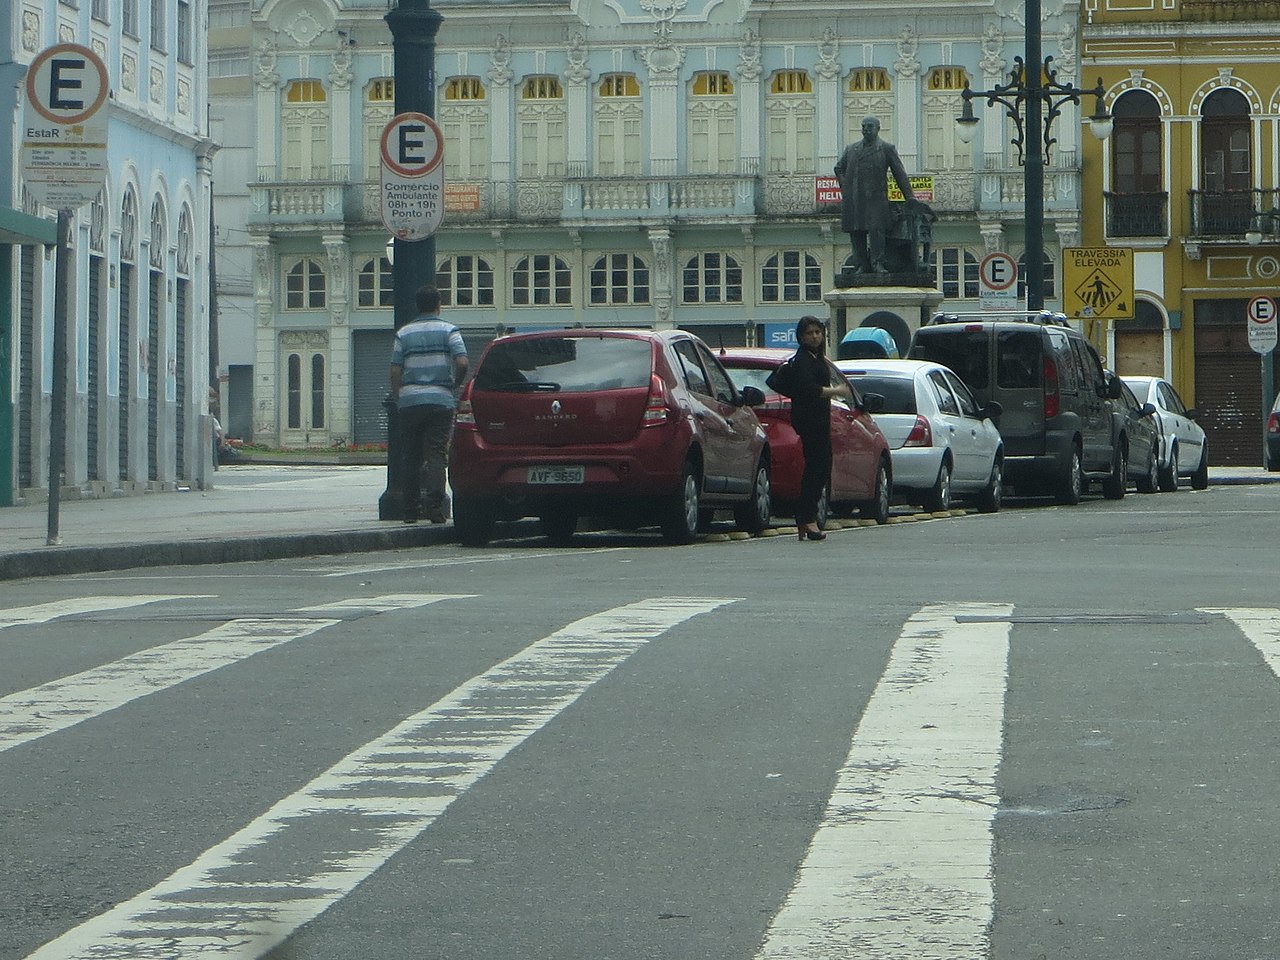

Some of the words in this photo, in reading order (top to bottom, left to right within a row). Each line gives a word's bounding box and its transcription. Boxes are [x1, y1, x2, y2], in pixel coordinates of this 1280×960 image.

[49, 59, 86, 109] E
[375, 80, 393, 99] RE
[27, 127, 60, 138] EstaR
[399, 125, 425, 164] E
[387, 191, 438, 200] Ambulante
[388, 201, 408, 209] 08h
[418, 201, 436, 209] 19h
[392, 209, 422, 218] Ponto
[1071, 250, 1126, 258] TRAVESSIA
[1075, 258, 1121, 267] ELEVADA
[991, 260, 1005, 282] E
[1256, 301, 1268, 319] E
